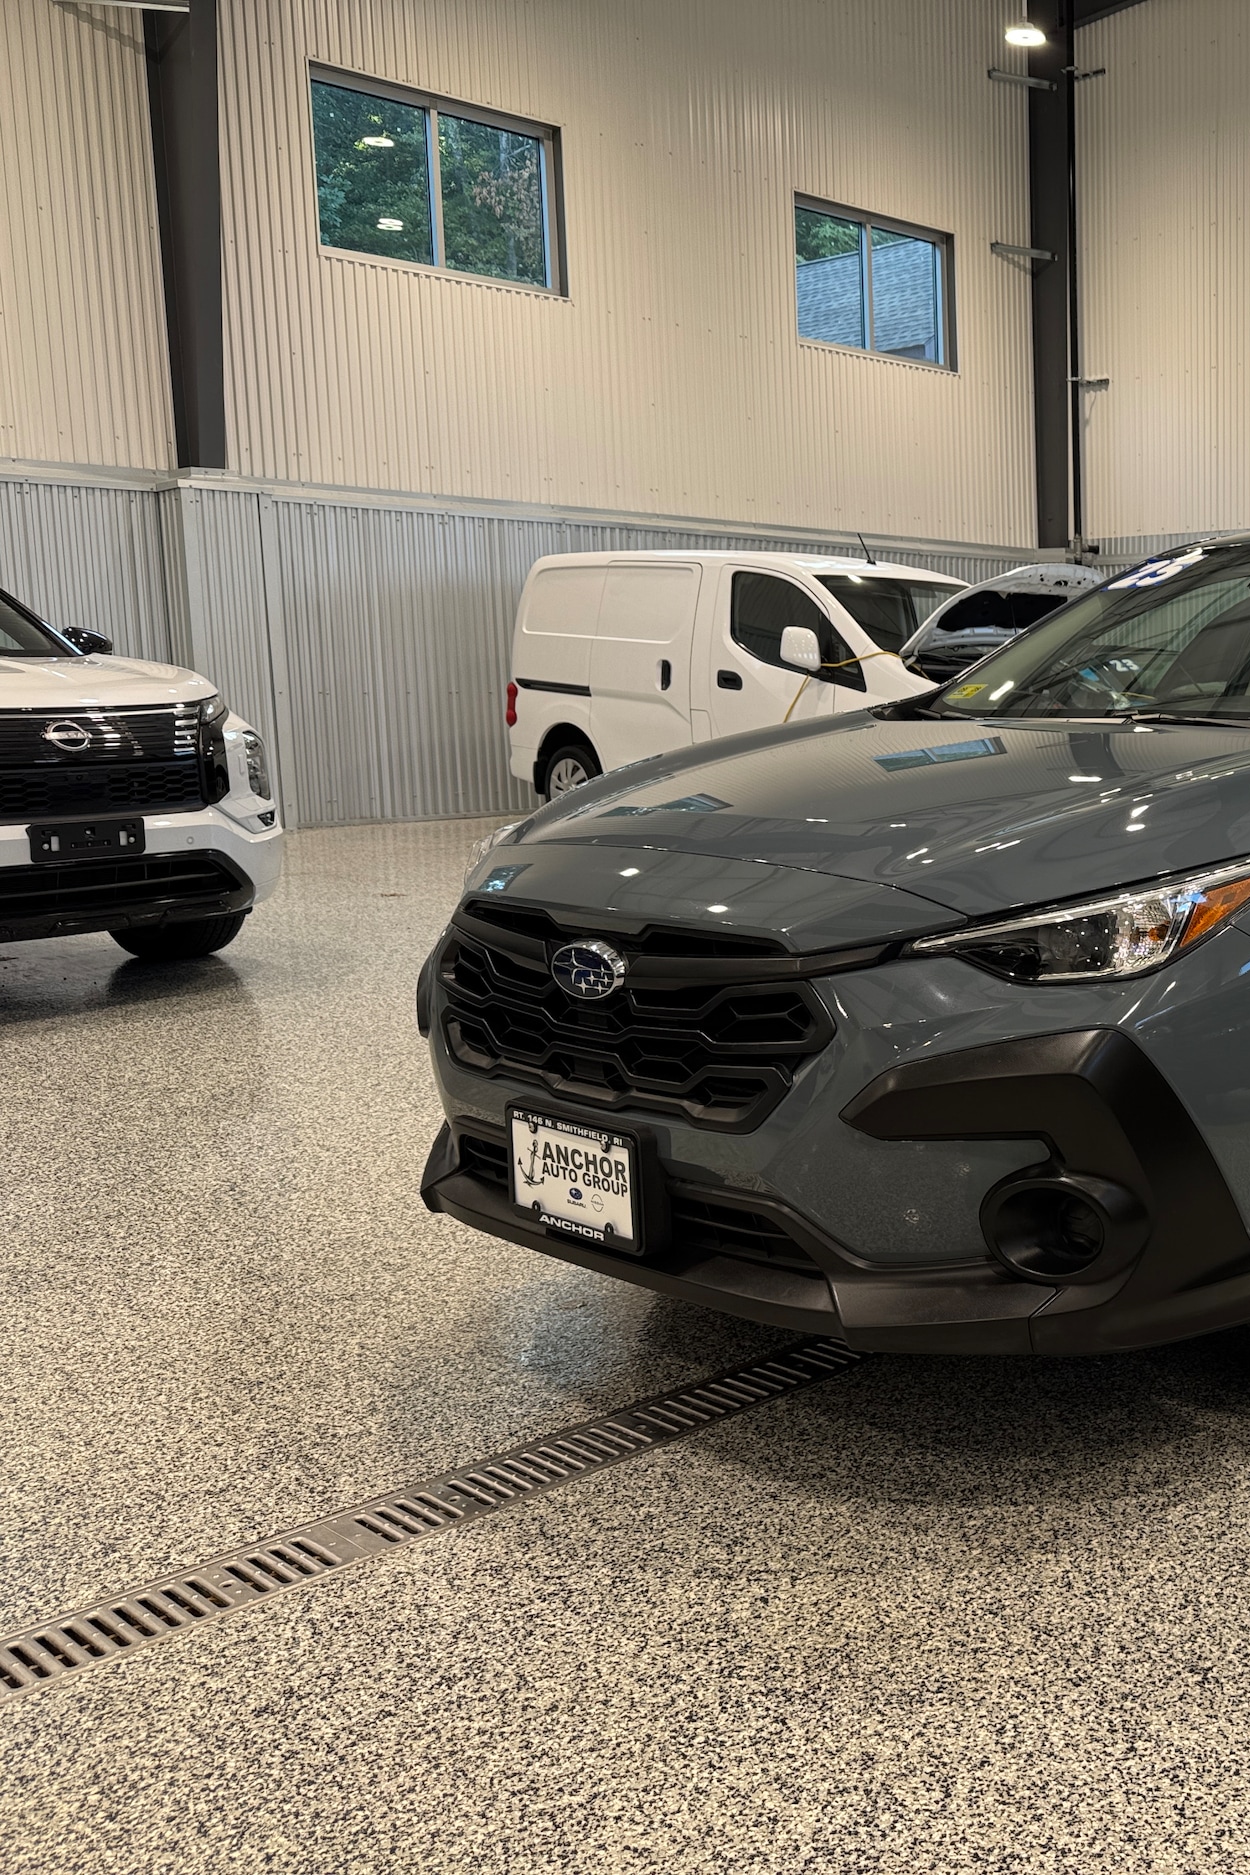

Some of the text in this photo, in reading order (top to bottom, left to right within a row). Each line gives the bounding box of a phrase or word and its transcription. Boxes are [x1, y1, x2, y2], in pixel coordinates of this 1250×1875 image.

[1109, 658, 1140, 673] 23
[513, 1110, 525, 1120] RT.
[527, 1114, 544, 1125] 146
[545, 1119, 555, 1129] N.
[613, 1136, 623, 1147] RI
[541, 1141, 628, 1184] ANCHOR
[541, 1161, 628, 1198] AUTO GROUP
[539, 1214, 605, 1242] ANCHOR
